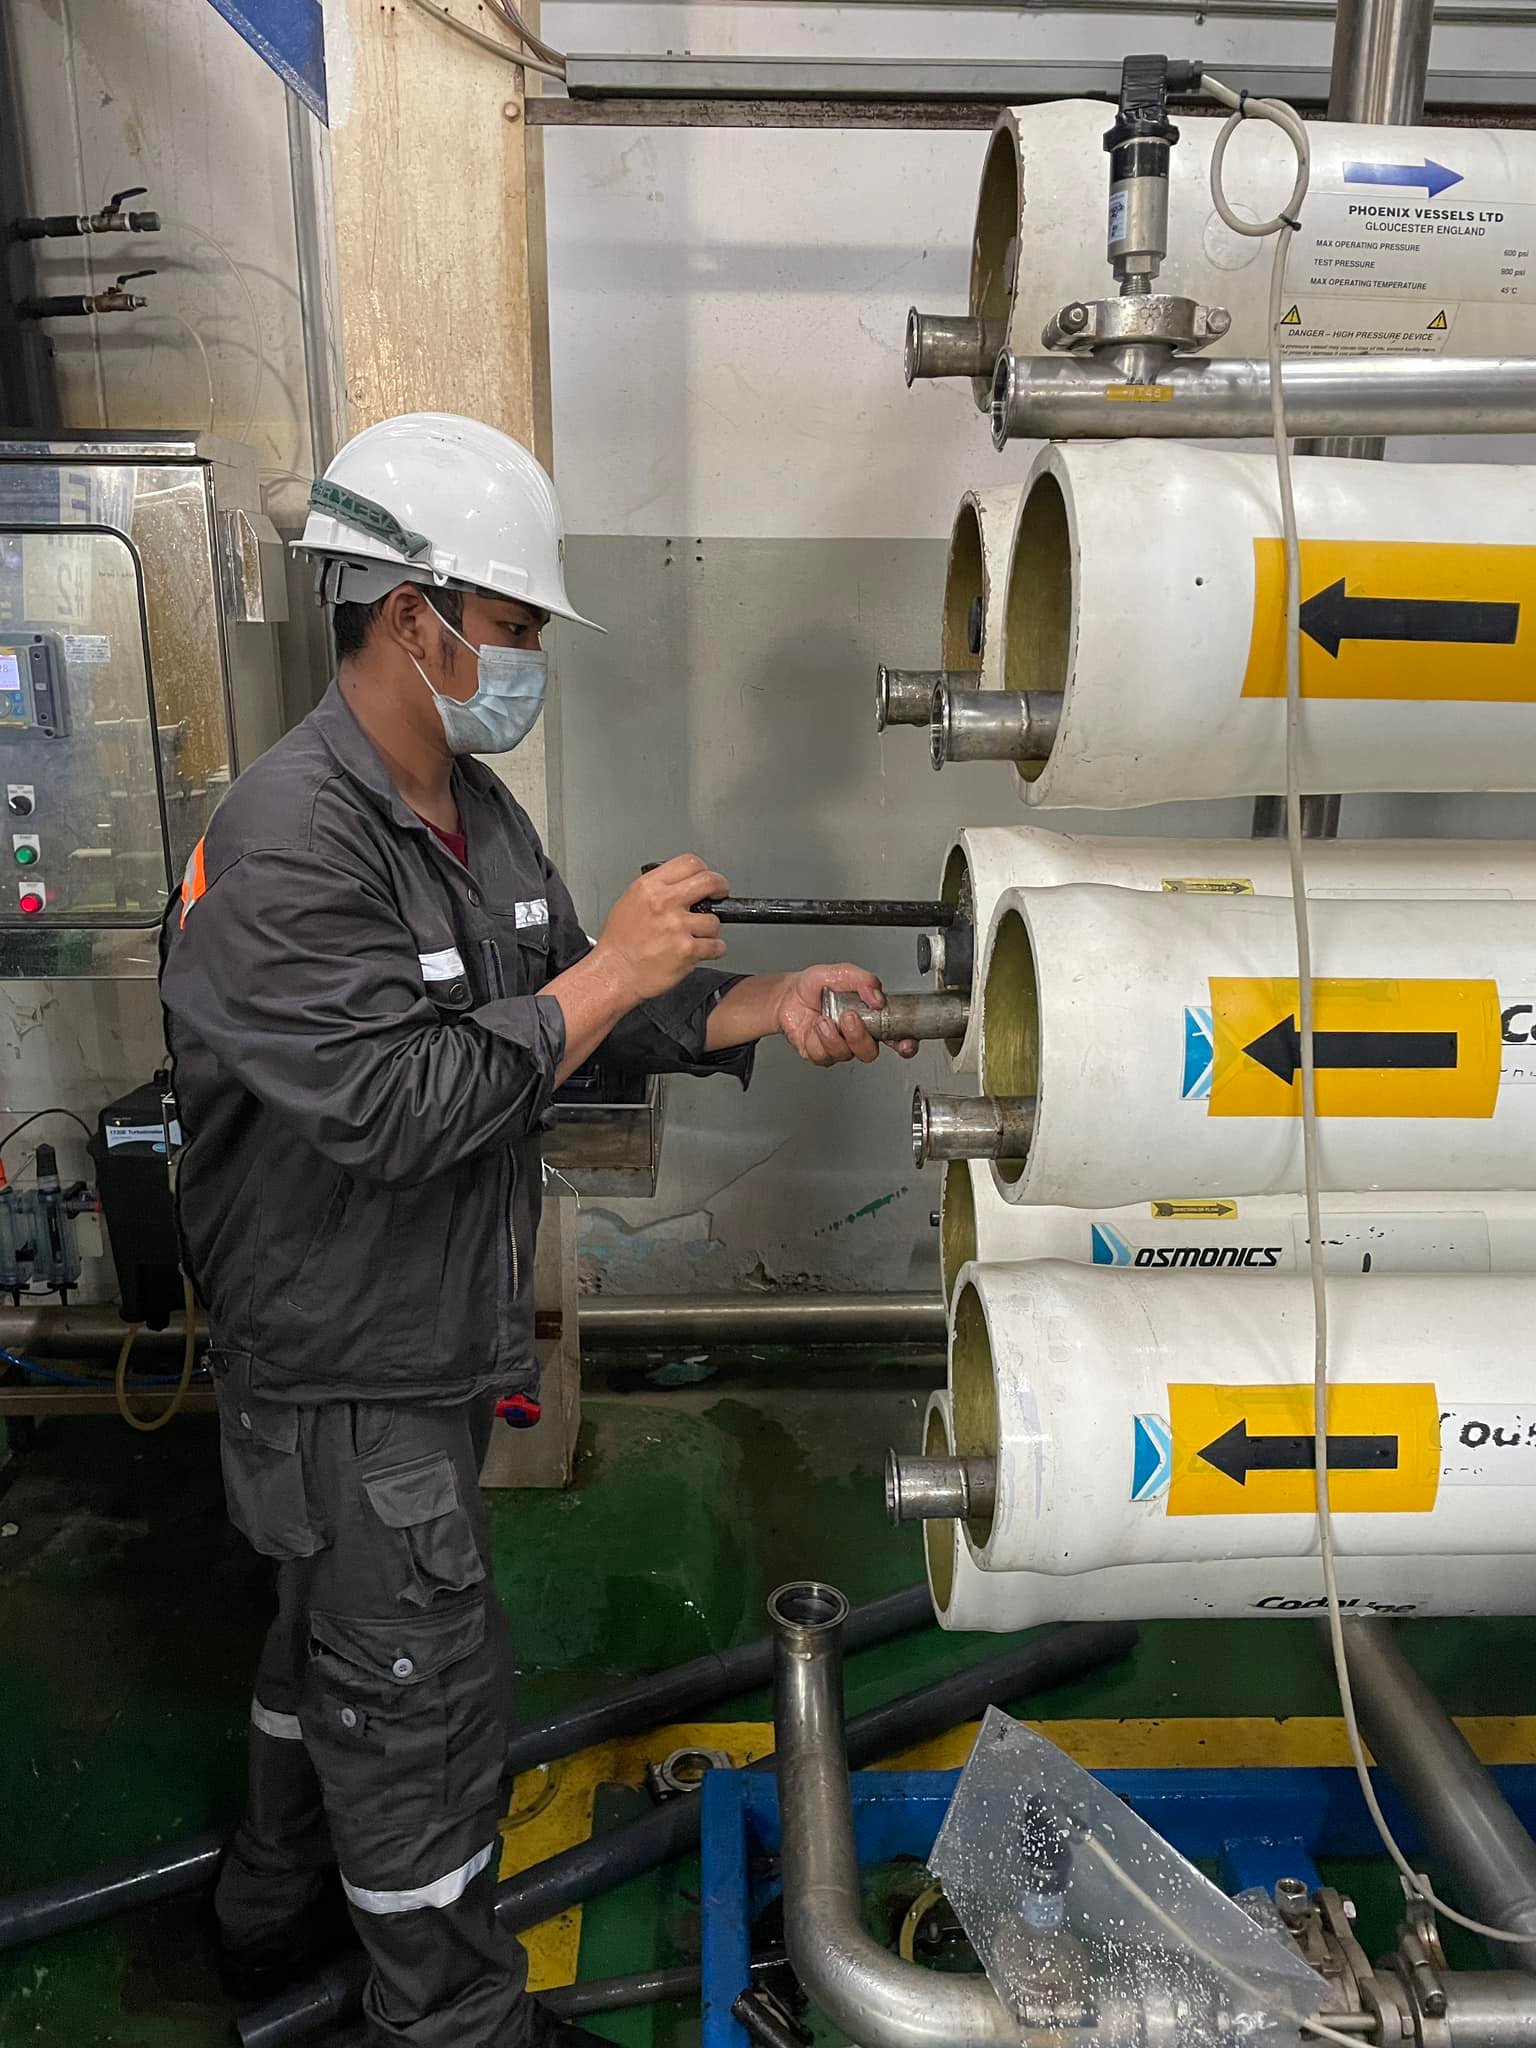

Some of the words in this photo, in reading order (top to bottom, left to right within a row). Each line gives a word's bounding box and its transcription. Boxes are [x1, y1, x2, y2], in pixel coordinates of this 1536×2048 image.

[1349, 205, 1410, 218] PHOENIX
[1414, 208, 1475, 221] VESSELS
[1479, 211, 1504, 223] LTD
[1365, 221, 1434, 234] GLOUCESTER
[1437, 225, 1486, 236] ENGLAND
[1316, 239, 1333, 248] MAX
[1335, 240, 1378, 250] OPERATING
[1379, 243, 1421, 251] PRESSURE
[1314, 258, 1333, 267] TEST
[1335, 260, 1376, 268] PRESSURE
[1310, 277, 1327, 285] MAX
[1328, 278, 1372, 288] OPERATING
[1373, 280, 1427, 290] TEMPERATURE
[1288, 329, 1325, 337] DANGER
[1333, 330, 1354, 338] HIGH
[1355, 331, 1400, 340] PRESSURE
[1402, 333, 1434, 341] DEVICE
[1134, 1247, 1283, 1267] OSMONICS
